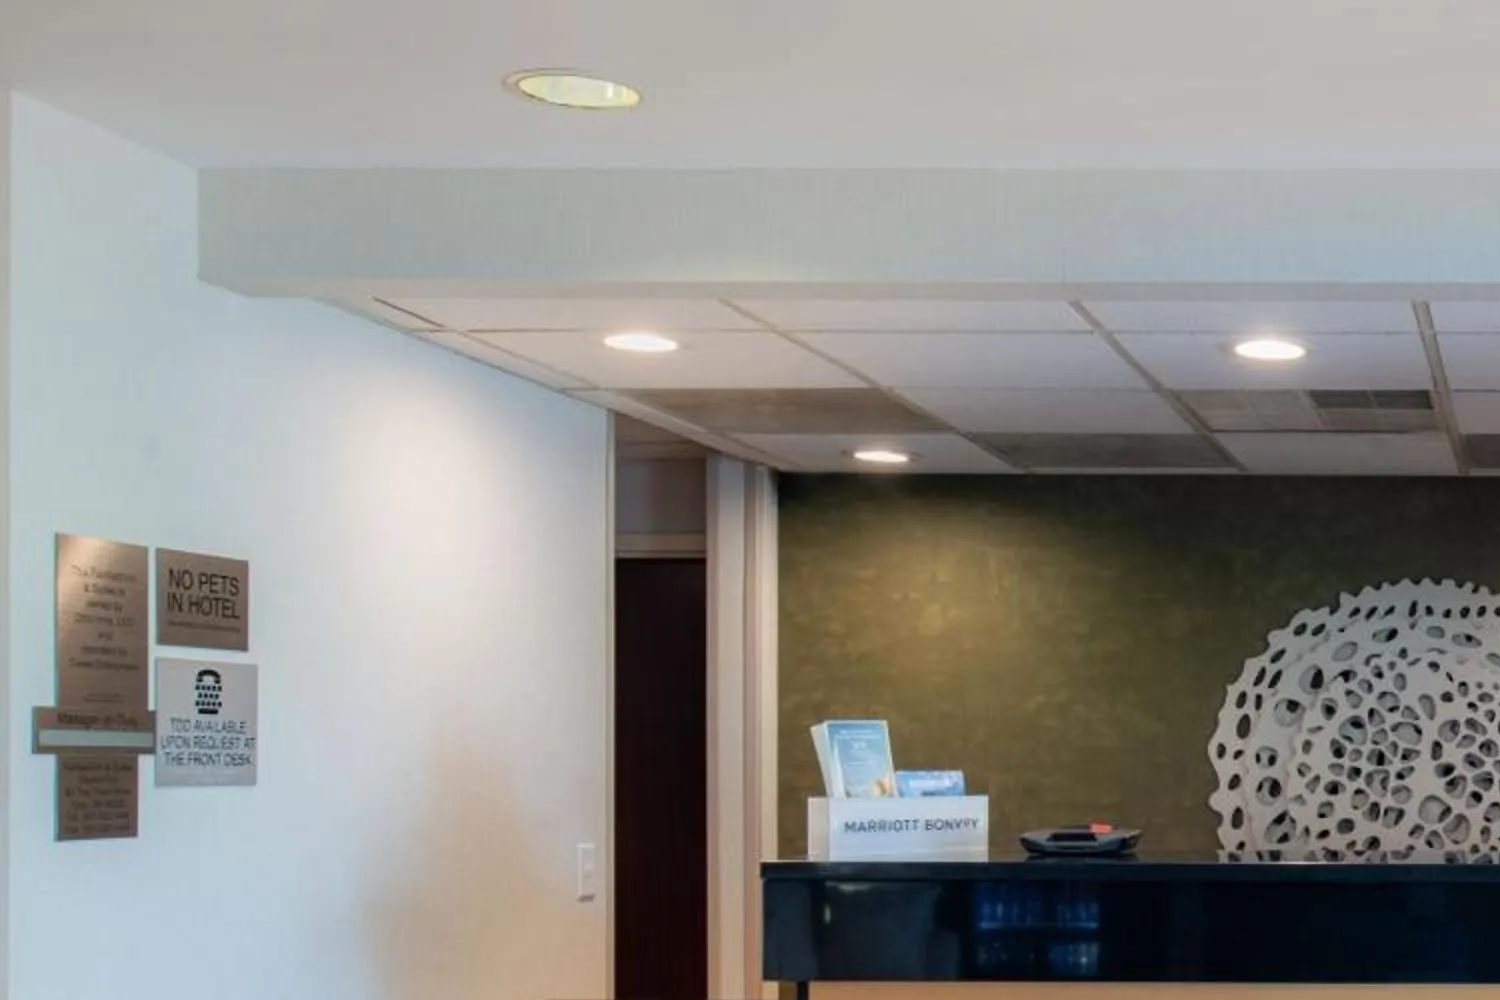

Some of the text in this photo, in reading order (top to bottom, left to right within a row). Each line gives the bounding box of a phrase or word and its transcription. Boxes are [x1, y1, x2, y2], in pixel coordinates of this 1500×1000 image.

[169, 568, 240, 597] NO PETS
[167, 591, 241, 619] IN HOTEL
[193, 719, 248, 735] AVAILABLE
[160, 735, 191, 750] UPON
[193, 735, 241, 751] REQUEST
[164, 751, 252, 768] THE FRONT DESK
[844, 817, 980, 833] MARRIOTT BONVOY
